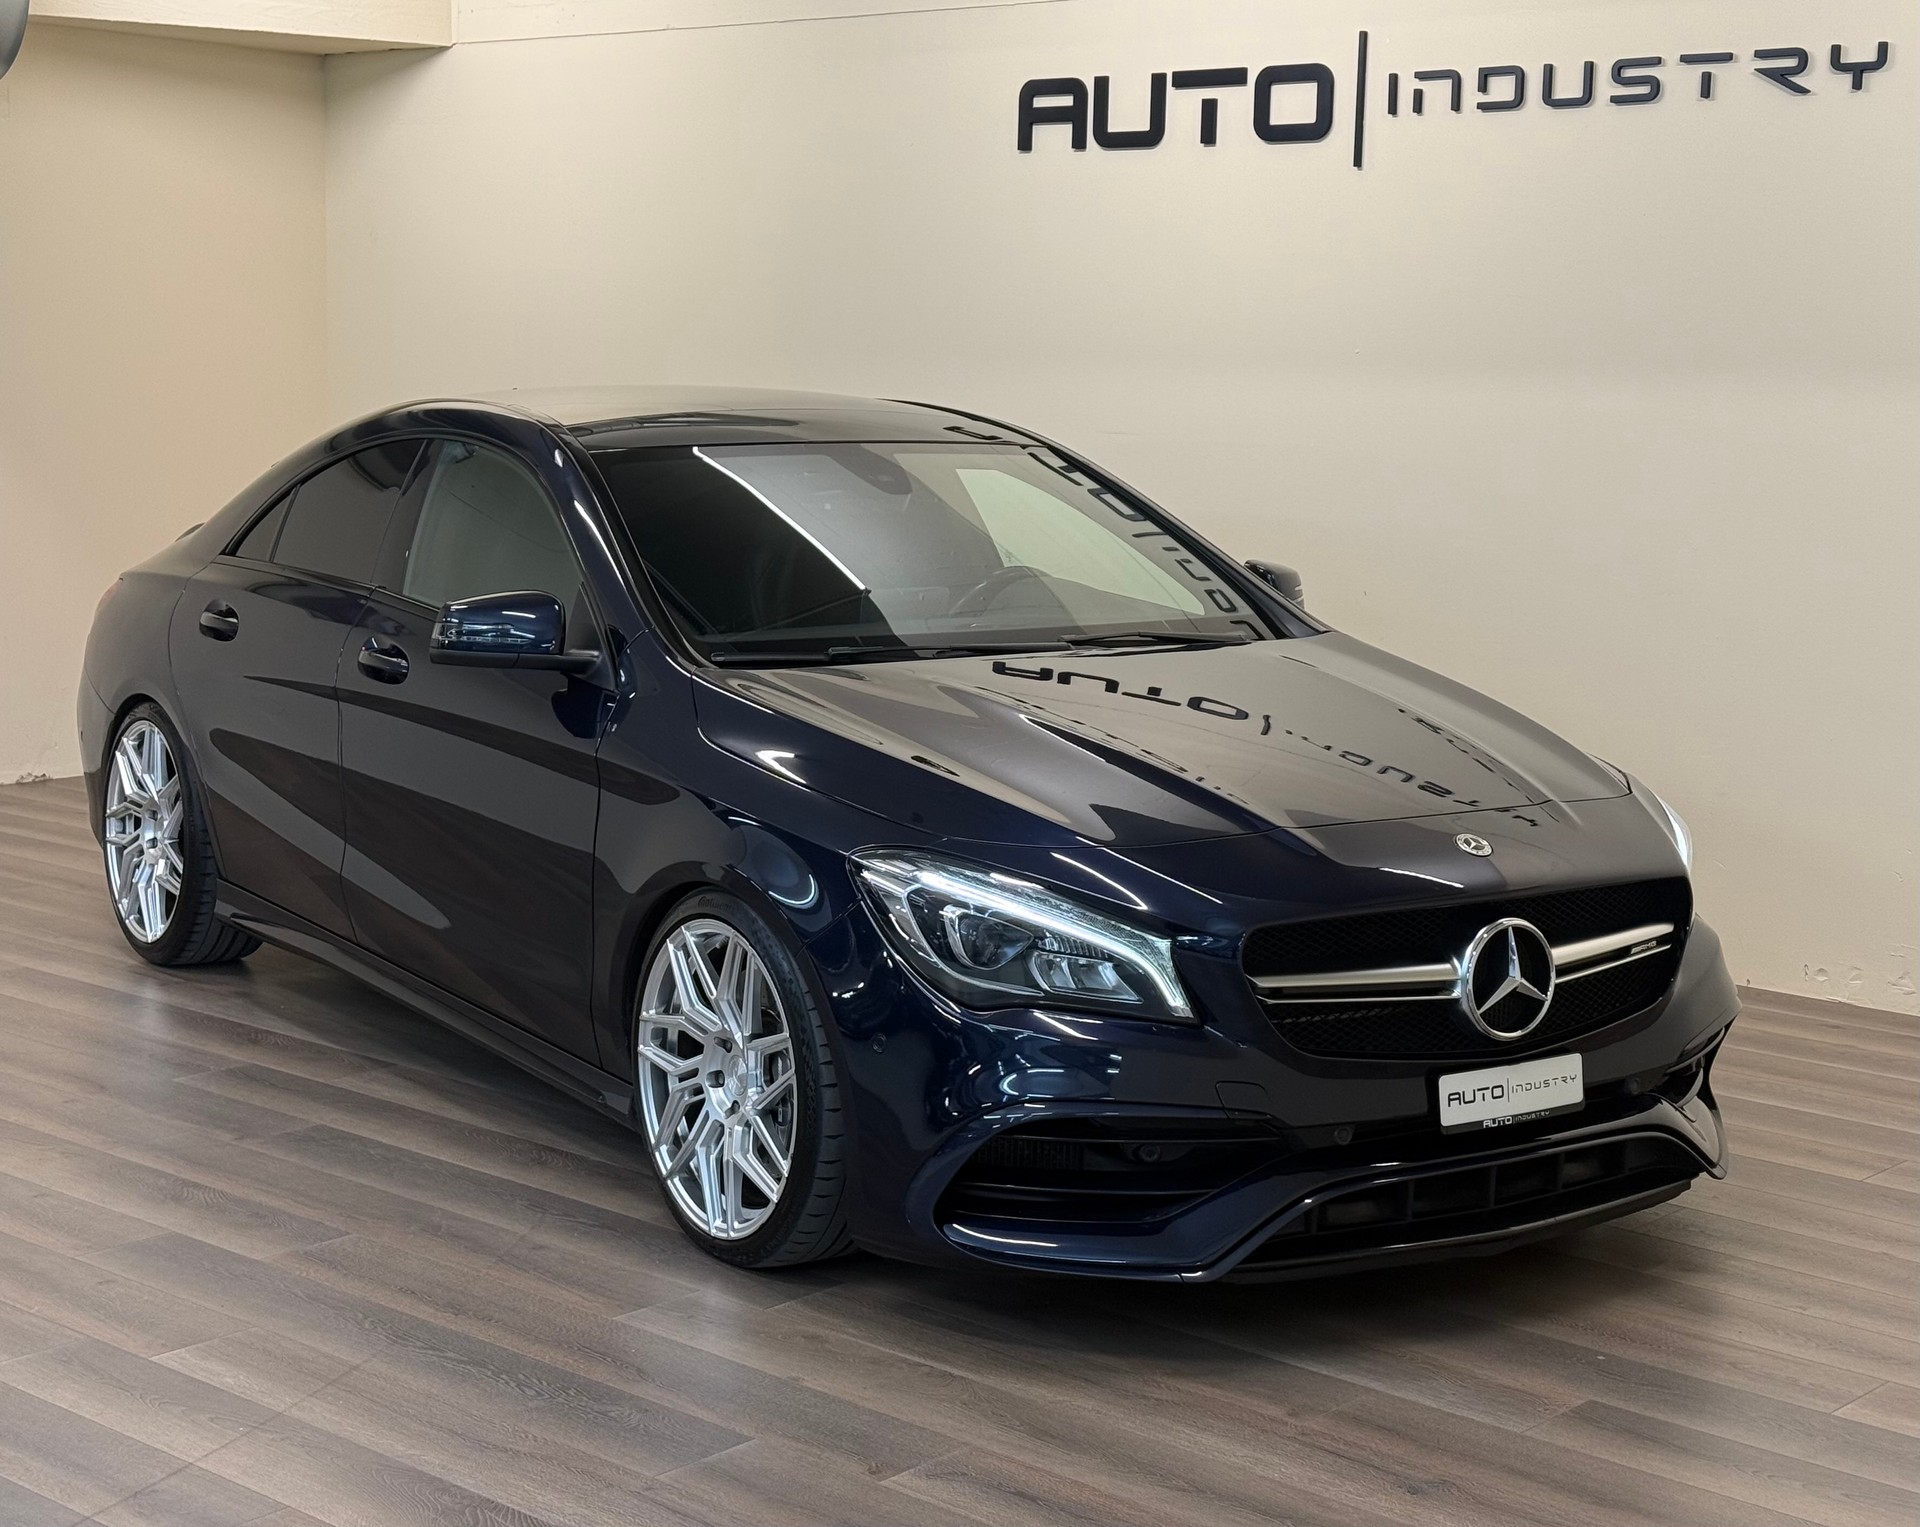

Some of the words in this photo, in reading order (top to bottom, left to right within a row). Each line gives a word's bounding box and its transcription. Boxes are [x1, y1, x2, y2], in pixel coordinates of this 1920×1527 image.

[1017, 63, 1334, 152] AUTO
[1447, 1084, 1505, 1107] AUTO
[1483, 1116, 1513, 1128] AUTO
